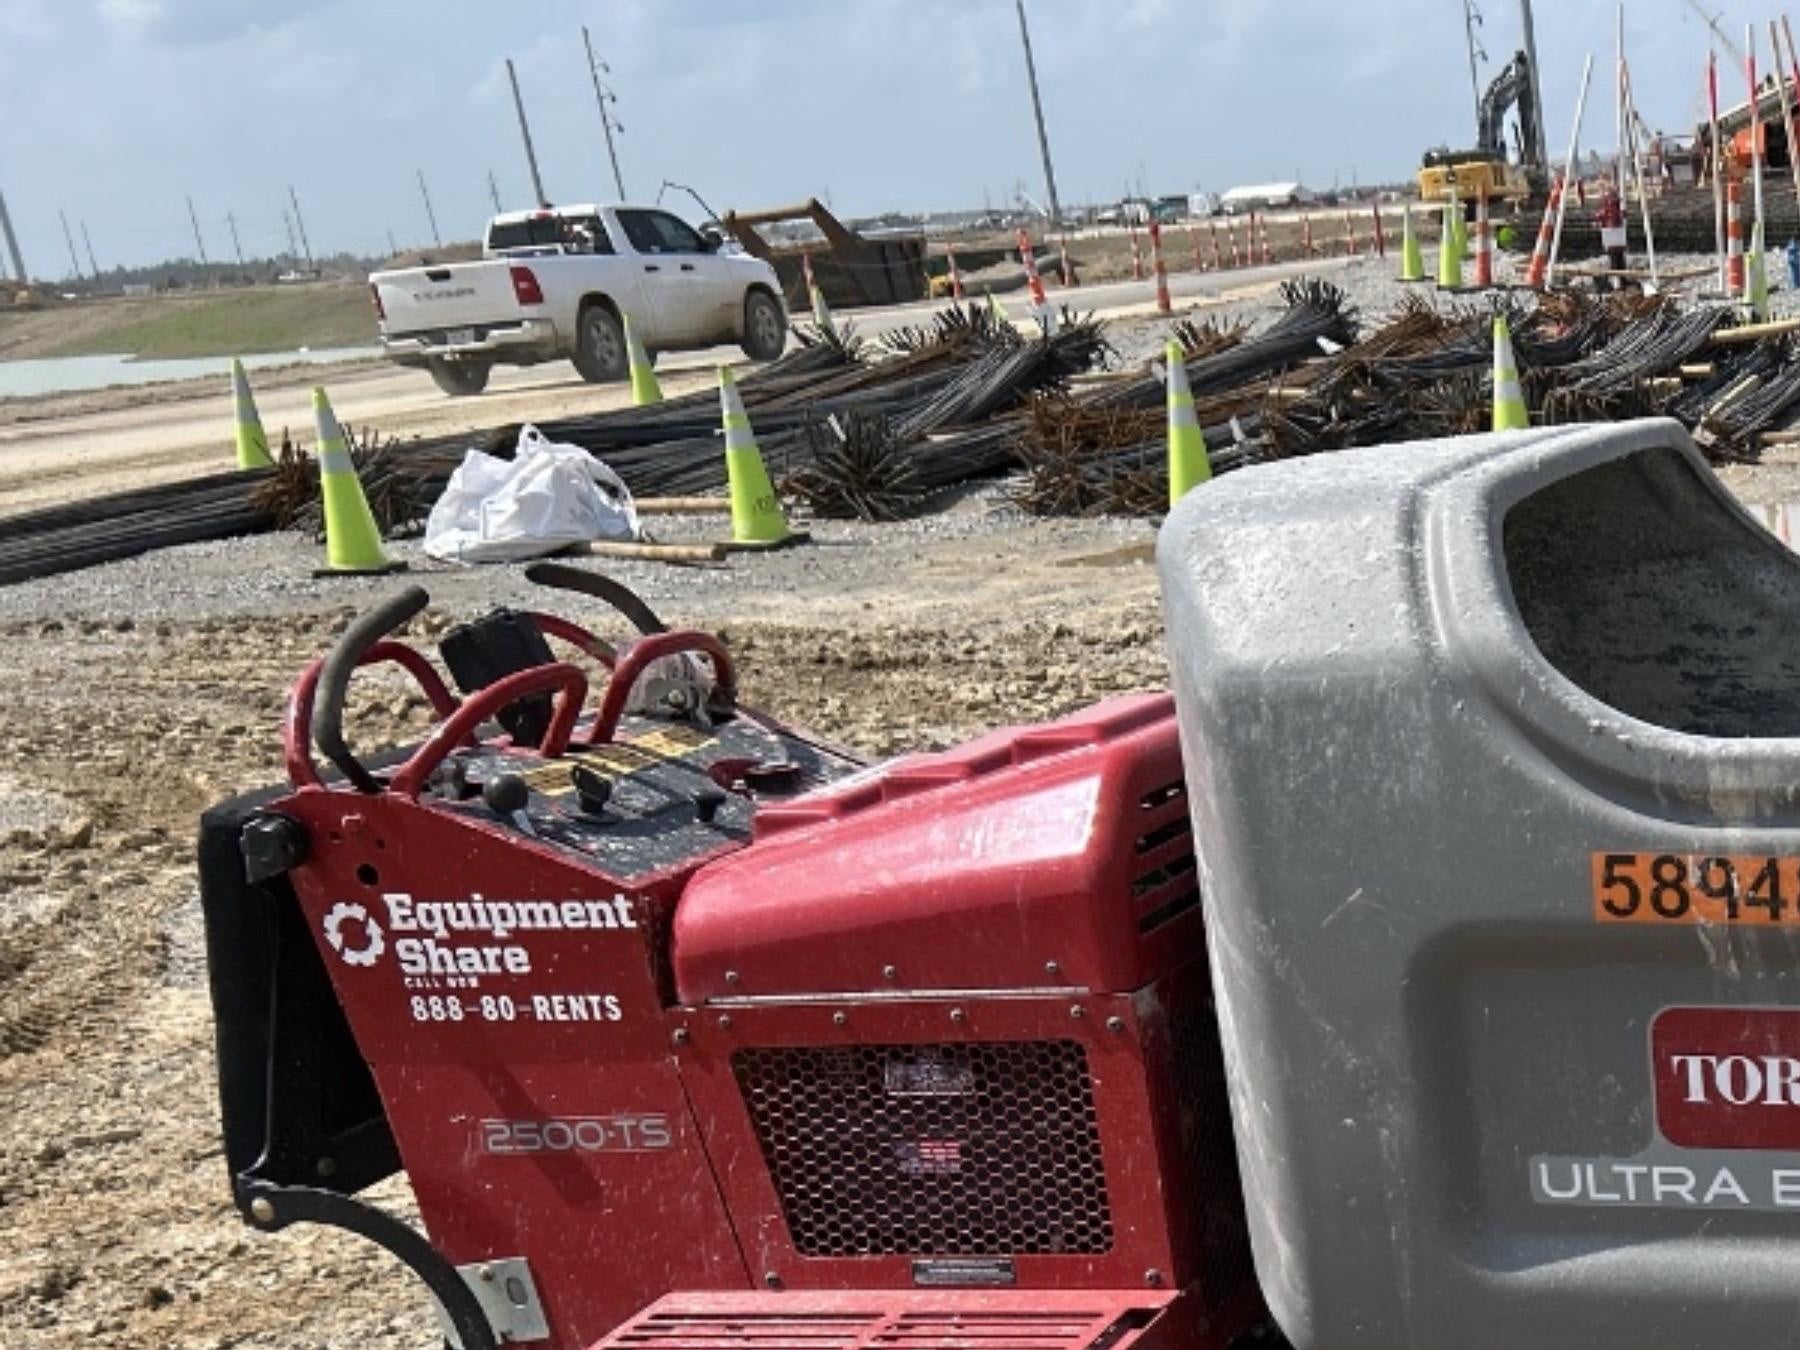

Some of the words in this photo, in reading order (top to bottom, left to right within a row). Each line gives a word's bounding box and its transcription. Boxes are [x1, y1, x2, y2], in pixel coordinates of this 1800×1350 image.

[382, 893, 637, 939] Equipment
[395, 938, 532, 974] Share
[410, 995, 623, 1022] 888-80-RENTS
[1539, 1162, 1751, 1204] ULTRA
